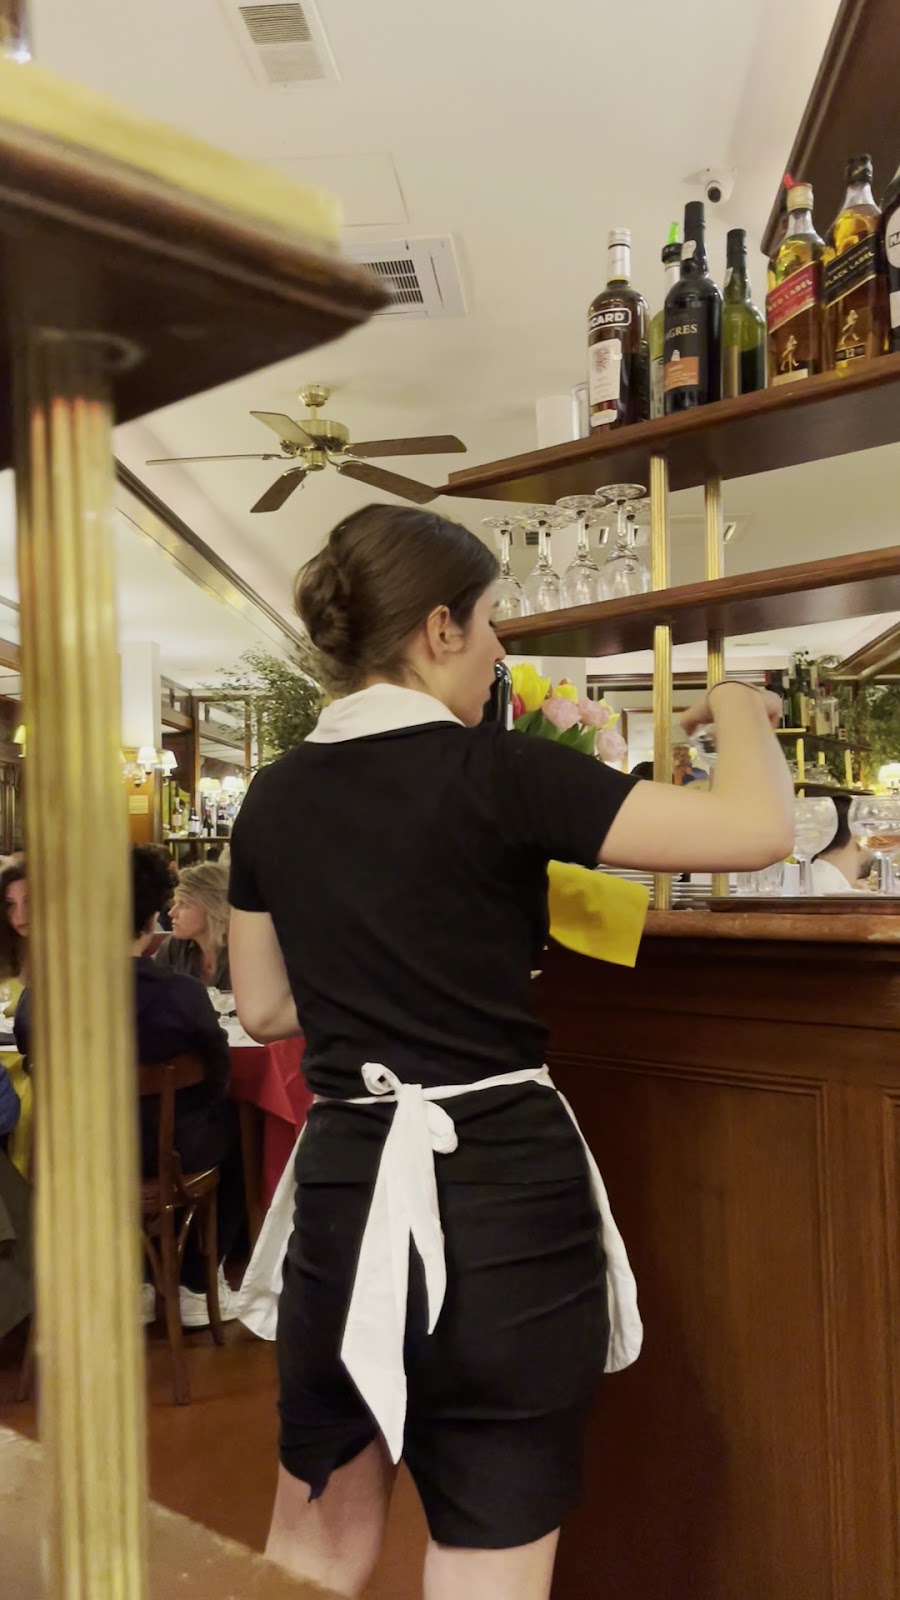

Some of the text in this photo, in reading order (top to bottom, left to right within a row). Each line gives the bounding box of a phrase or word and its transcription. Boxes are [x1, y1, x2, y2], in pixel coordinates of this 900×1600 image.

[849, 251, 875, 270] LABEL
[784, 279, 814, 300] LABEL
[589, 312, 625, 327] CARD
[845, 348, 856, 358] 12
